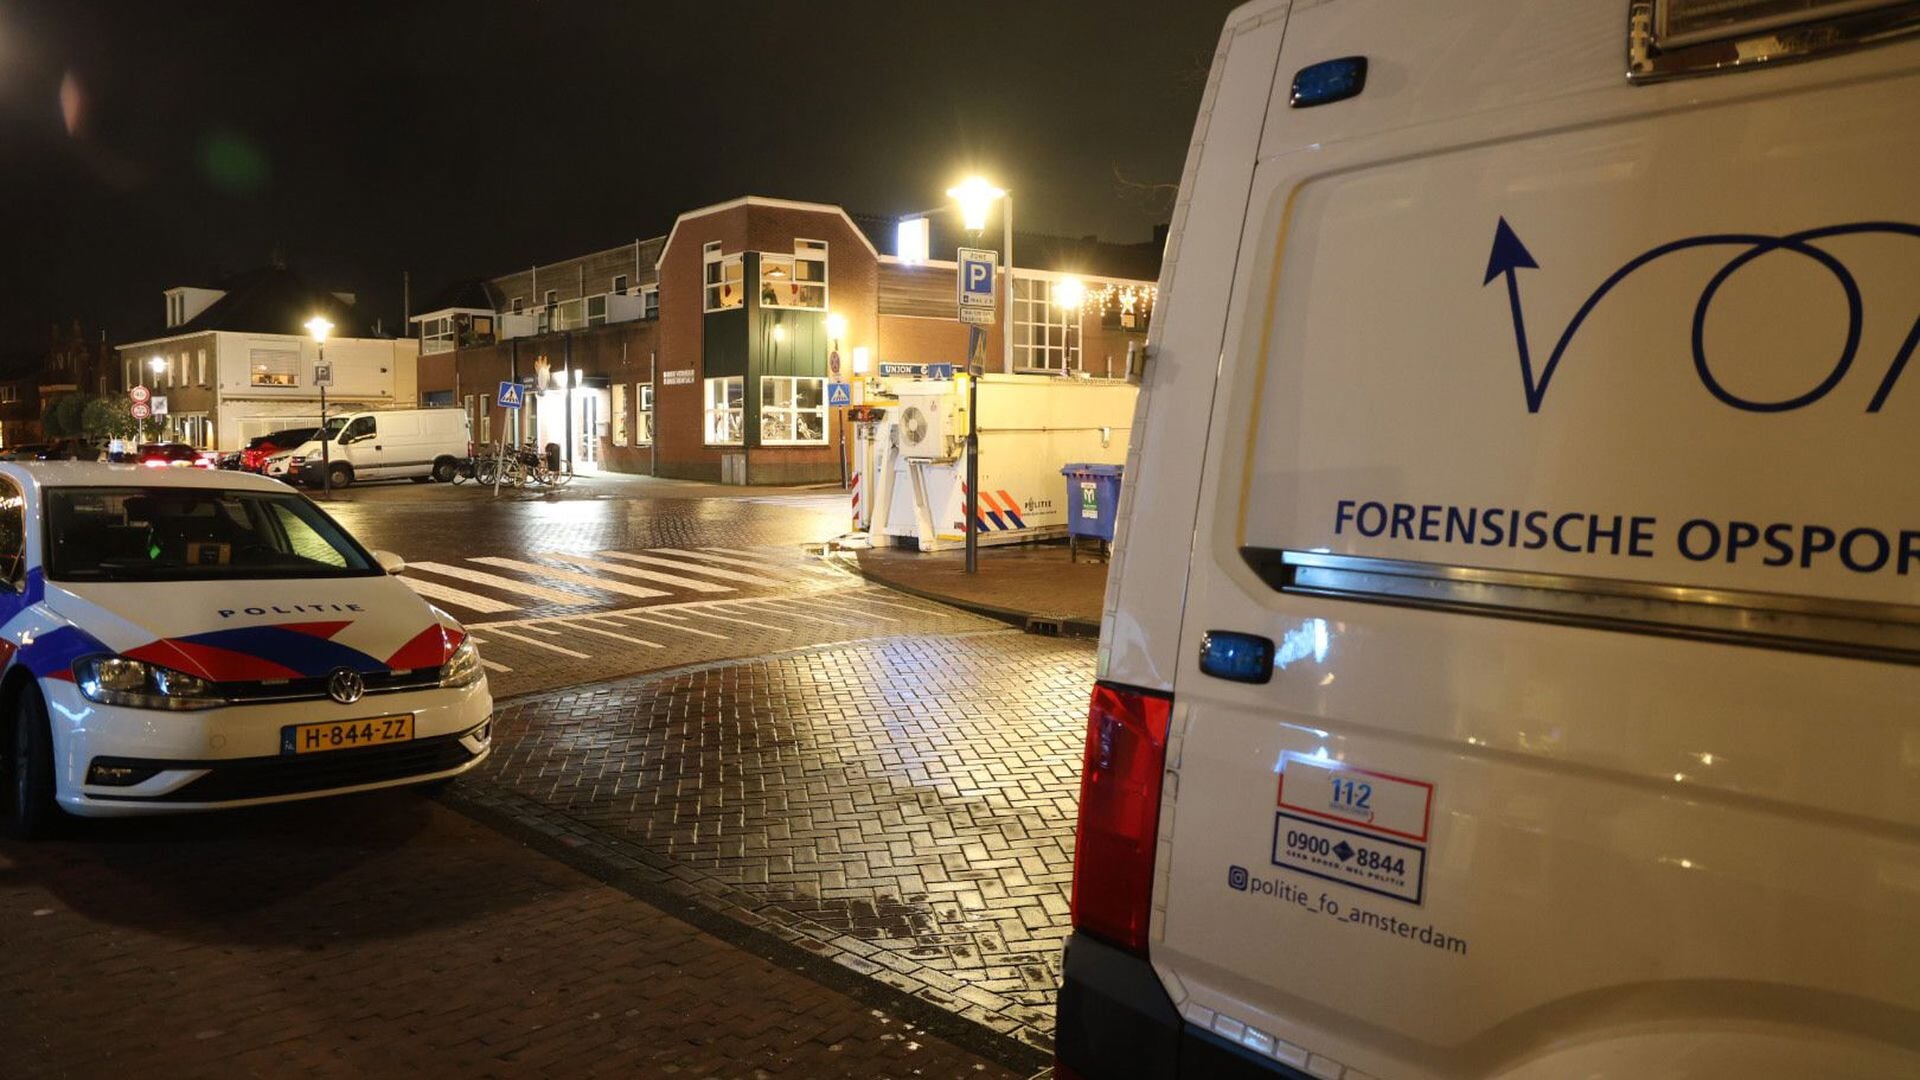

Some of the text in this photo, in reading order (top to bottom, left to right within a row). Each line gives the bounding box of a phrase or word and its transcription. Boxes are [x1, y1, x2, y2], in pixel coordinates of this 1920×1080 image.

[970, 264, 987, 290] P
[1334, 499, 1658, 558] FORENSISCHE
[218, 603, 365, 618] POLITIE
[305, 719, 406, 749] H-844-ZZ
[1287, 830, 1406, 876] 0900 8844
[1250, 876, 1467, 955] politie_fo_amsterdam
